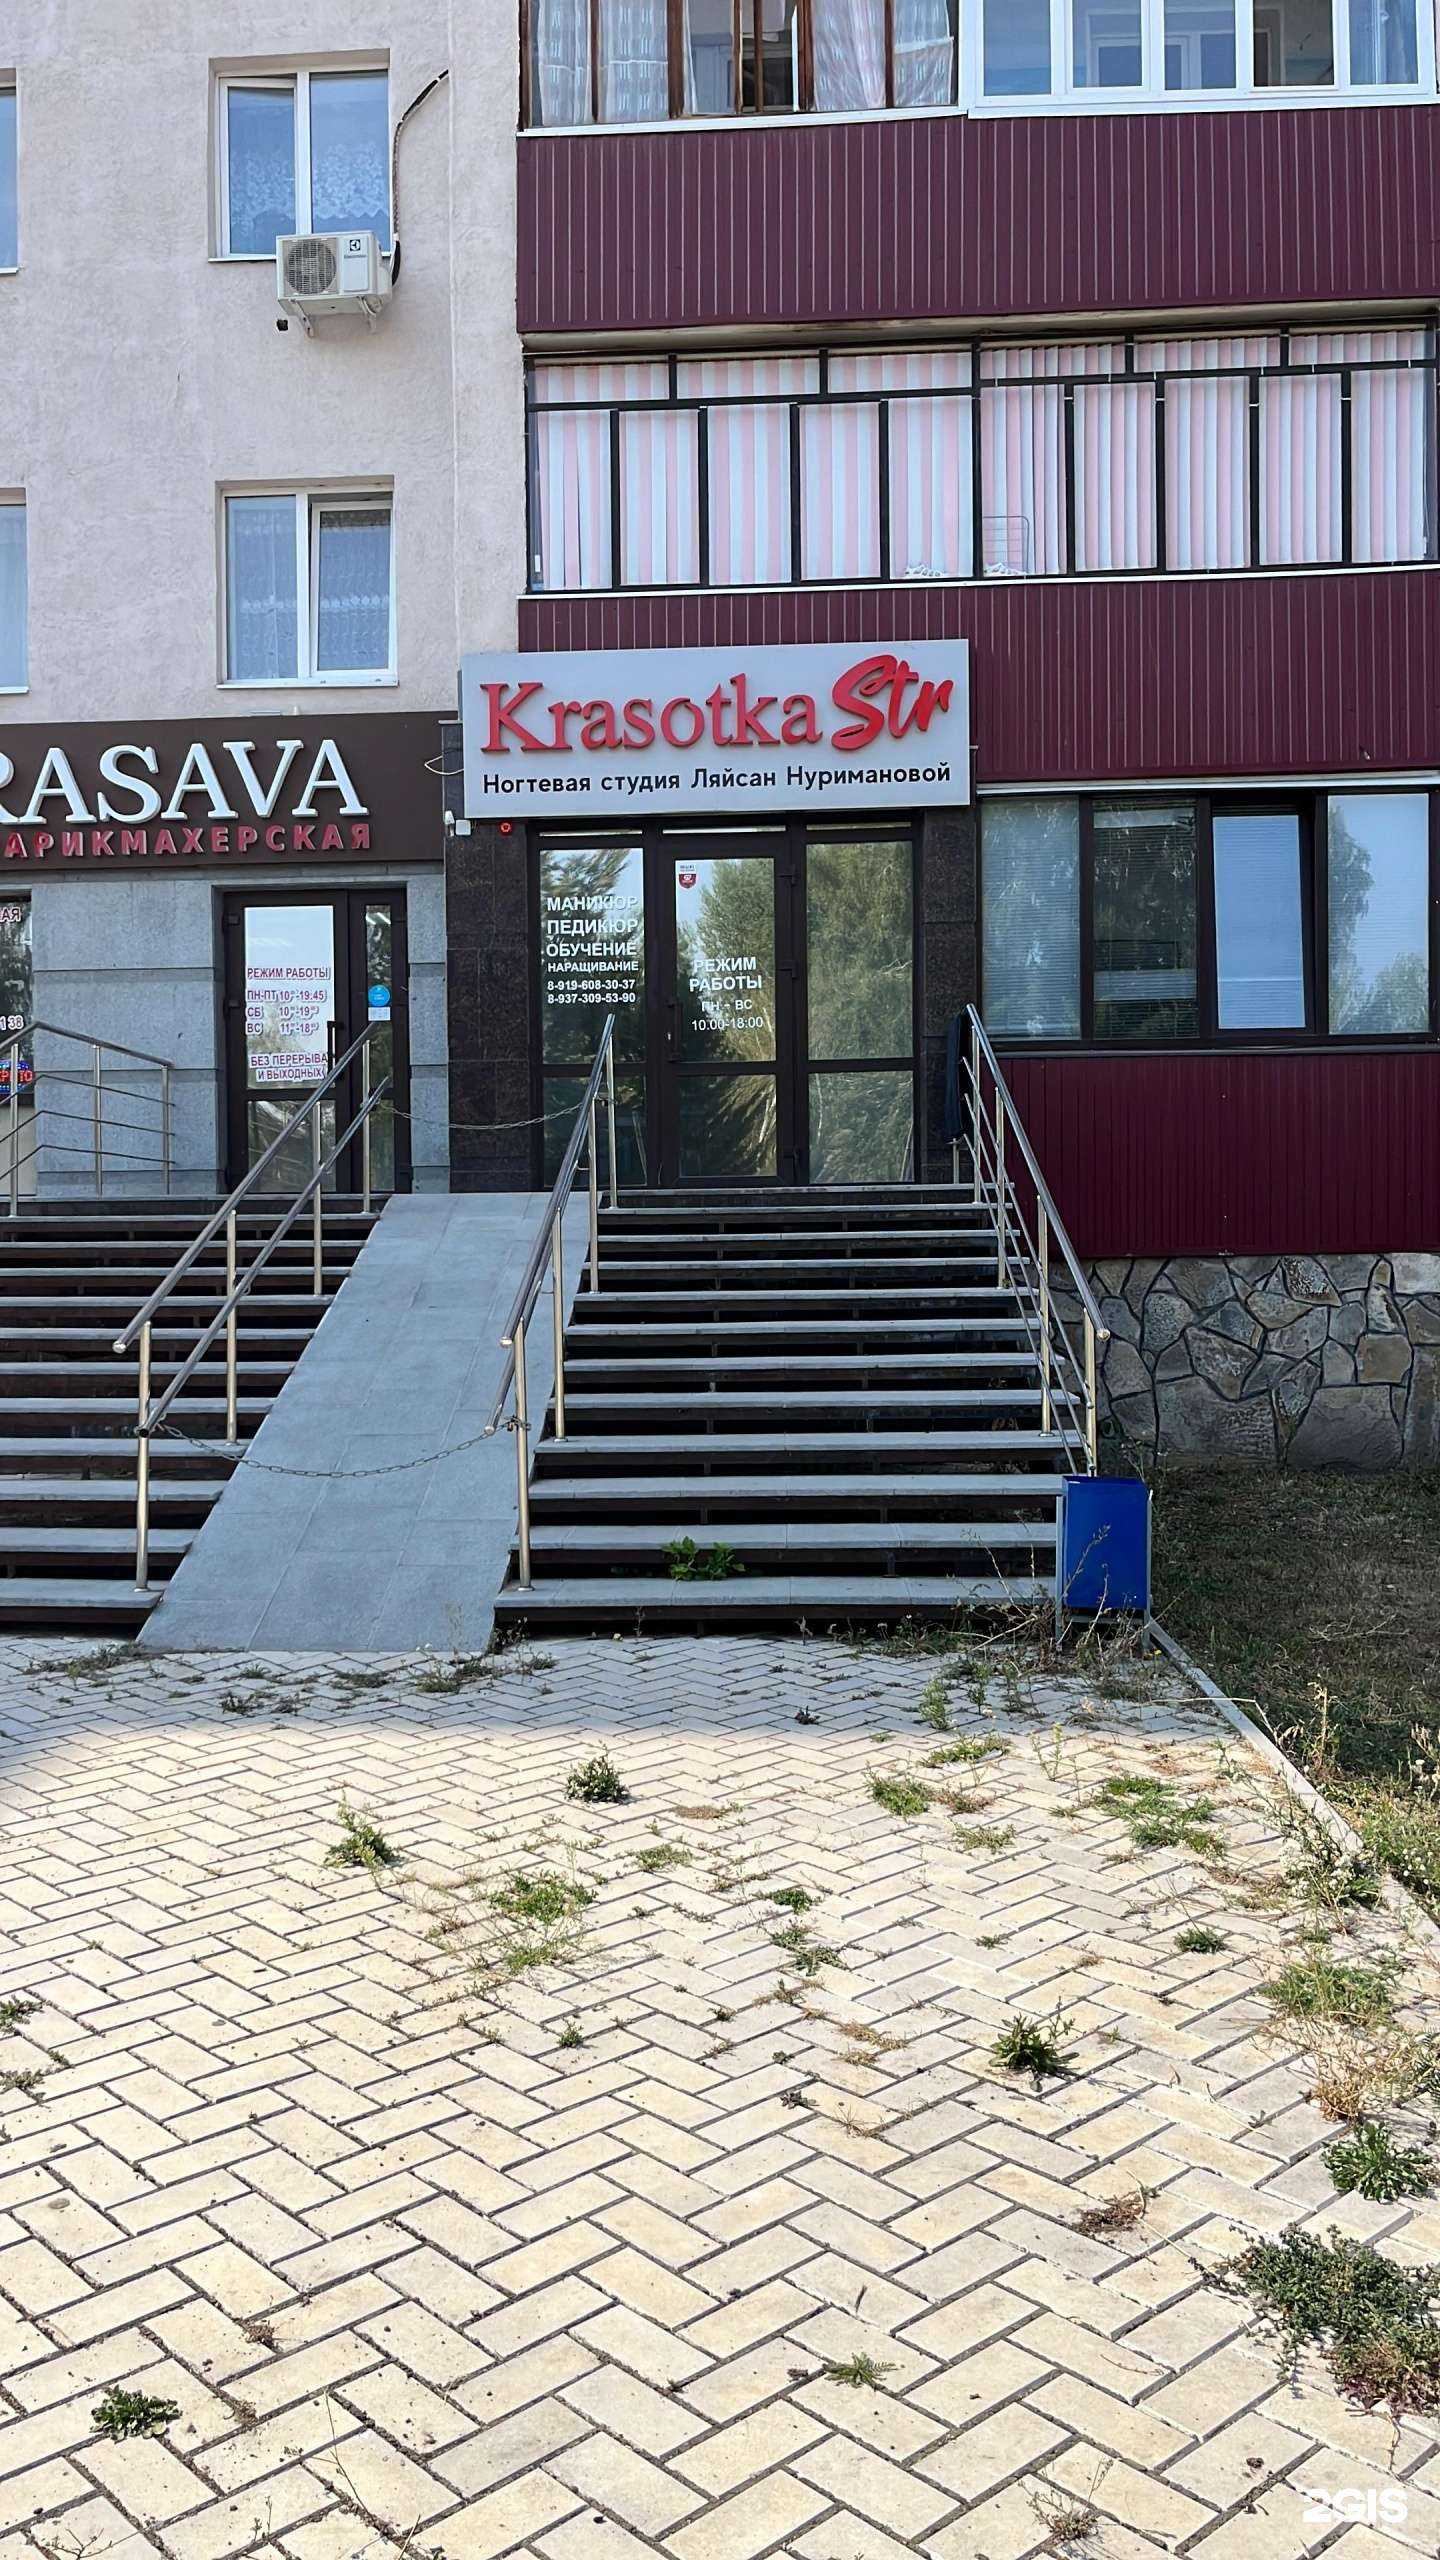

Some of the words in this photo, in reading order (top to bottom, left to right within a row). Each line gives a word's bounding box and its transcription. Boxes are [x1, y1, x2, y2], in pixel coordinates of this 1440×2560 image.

[480, 672, 823, 753] Krasotka
[831, 654, 955, 750] Str
[482, 773, 591, 795] Ногтевая
[600, 772, 681, 794] студия
[691, 767, 777, 790] Ляйсан
[786, 761, 952, 786] Нуримановой
[547, 895, 638, 911] МАНИКЮР
[547, 918, 638, 936] ПЕДИКЮР
[546, 942, 637, 957] ОБУЧЕНИЕ
[547, 961, 639, 973] НАРАЩИВАНИЕ
[693, 956, 757, 973] РЕЖИМ
[247, 967, 283, 978] РЕЖИМ
[286, 967, 328, 978] РАБОТЫ
[547, 980, 636, 990] 8-919-608-30-37
[689, 975, 762, 992] РАБОТЫ
[247, 989, 276, 1000] ПН-ПТ
[547, 993, 636, 1004] 8-937-309-53-90
[735, 999, 753, 1010] ВС
[247, 1007, 261, 1017] СБ
[247, 1023, 261, 1033] ВС
[250, 1055, 270, 1067] БЕЗ
[258, 1070, 265, 1080] И
[266, 1067, 323, 1080] ВЫХОДНЫХ
